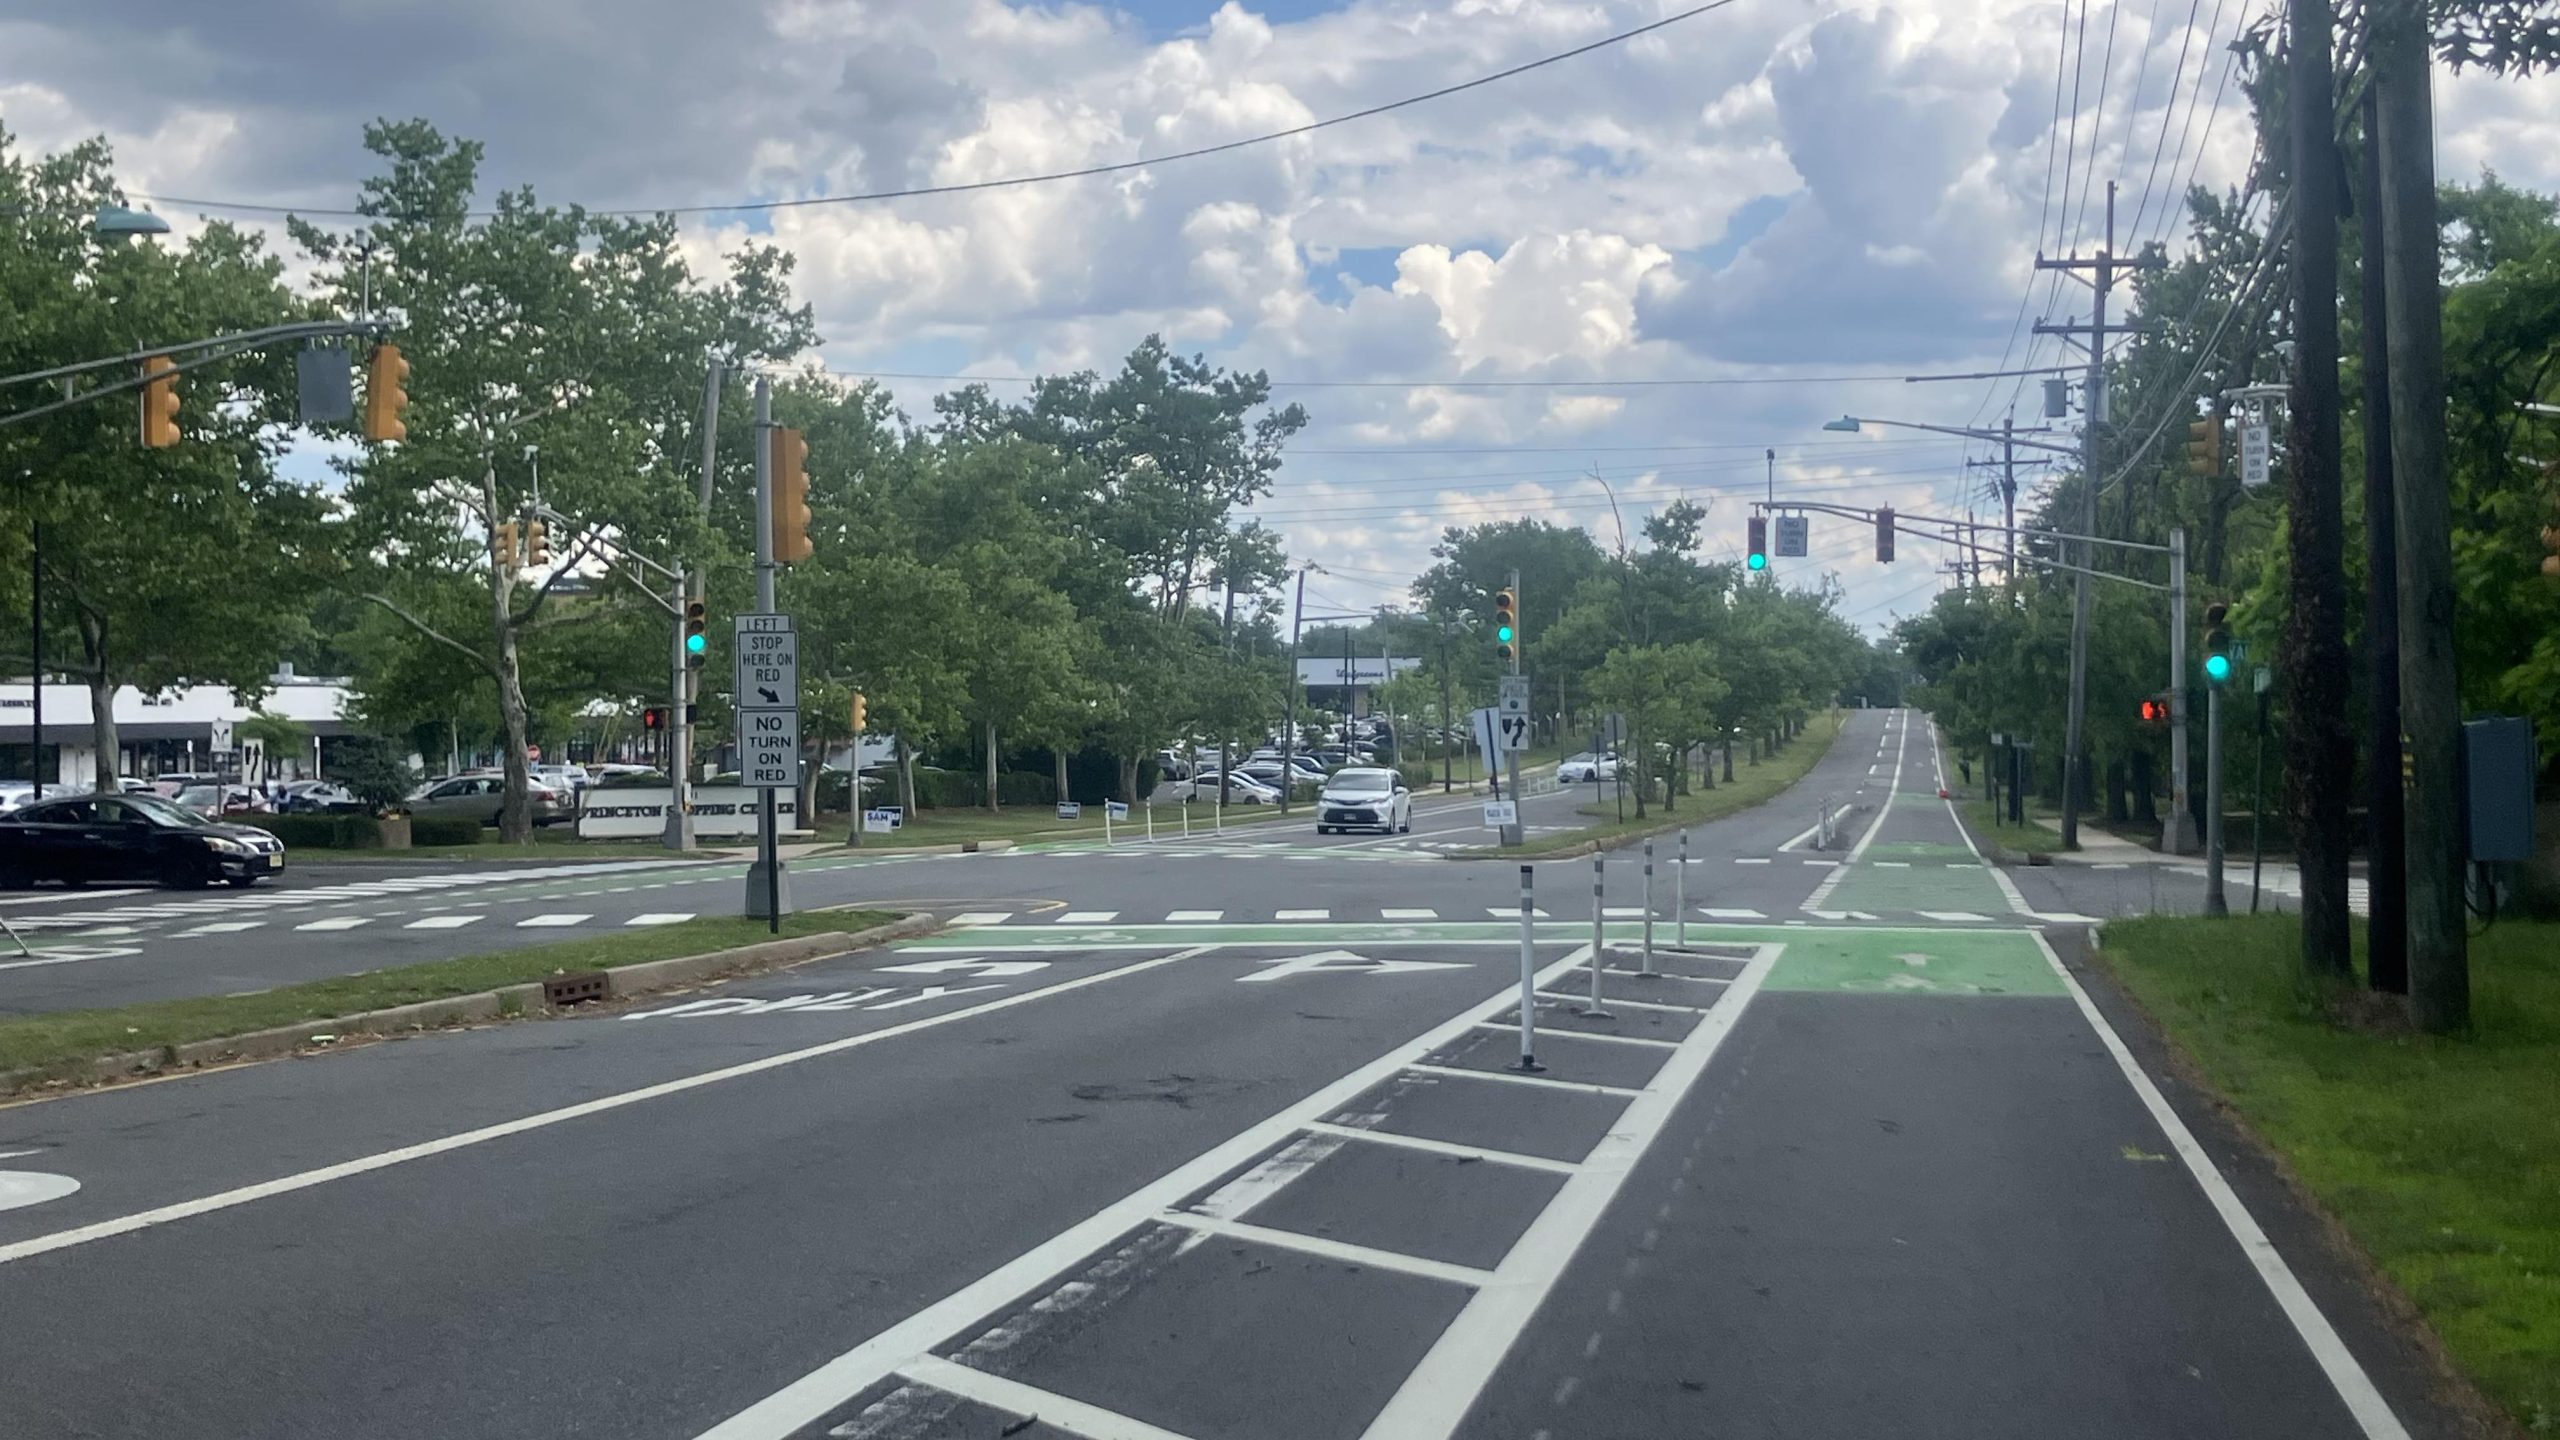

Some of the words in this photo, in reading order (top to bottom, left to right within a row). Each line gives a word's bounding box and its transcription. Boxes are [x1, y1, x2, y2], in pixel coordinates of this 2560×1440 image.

[2248, 431, 2261, 441] NO
[746, 618, 778, 631] LEFT
[752, 636, 783, 650] STOP
[743, 653, 772, 666] HERE
[777, 652, 793, 665] ON
[756, 669, 781, 682] RED
[756, 717, 783, 731] NO
[749, 736, 791, 748] TURN
[759, 752, 782, 765] ON
[754, 769, 786, 782] RED
[739, 802, 795, 815] CEER
